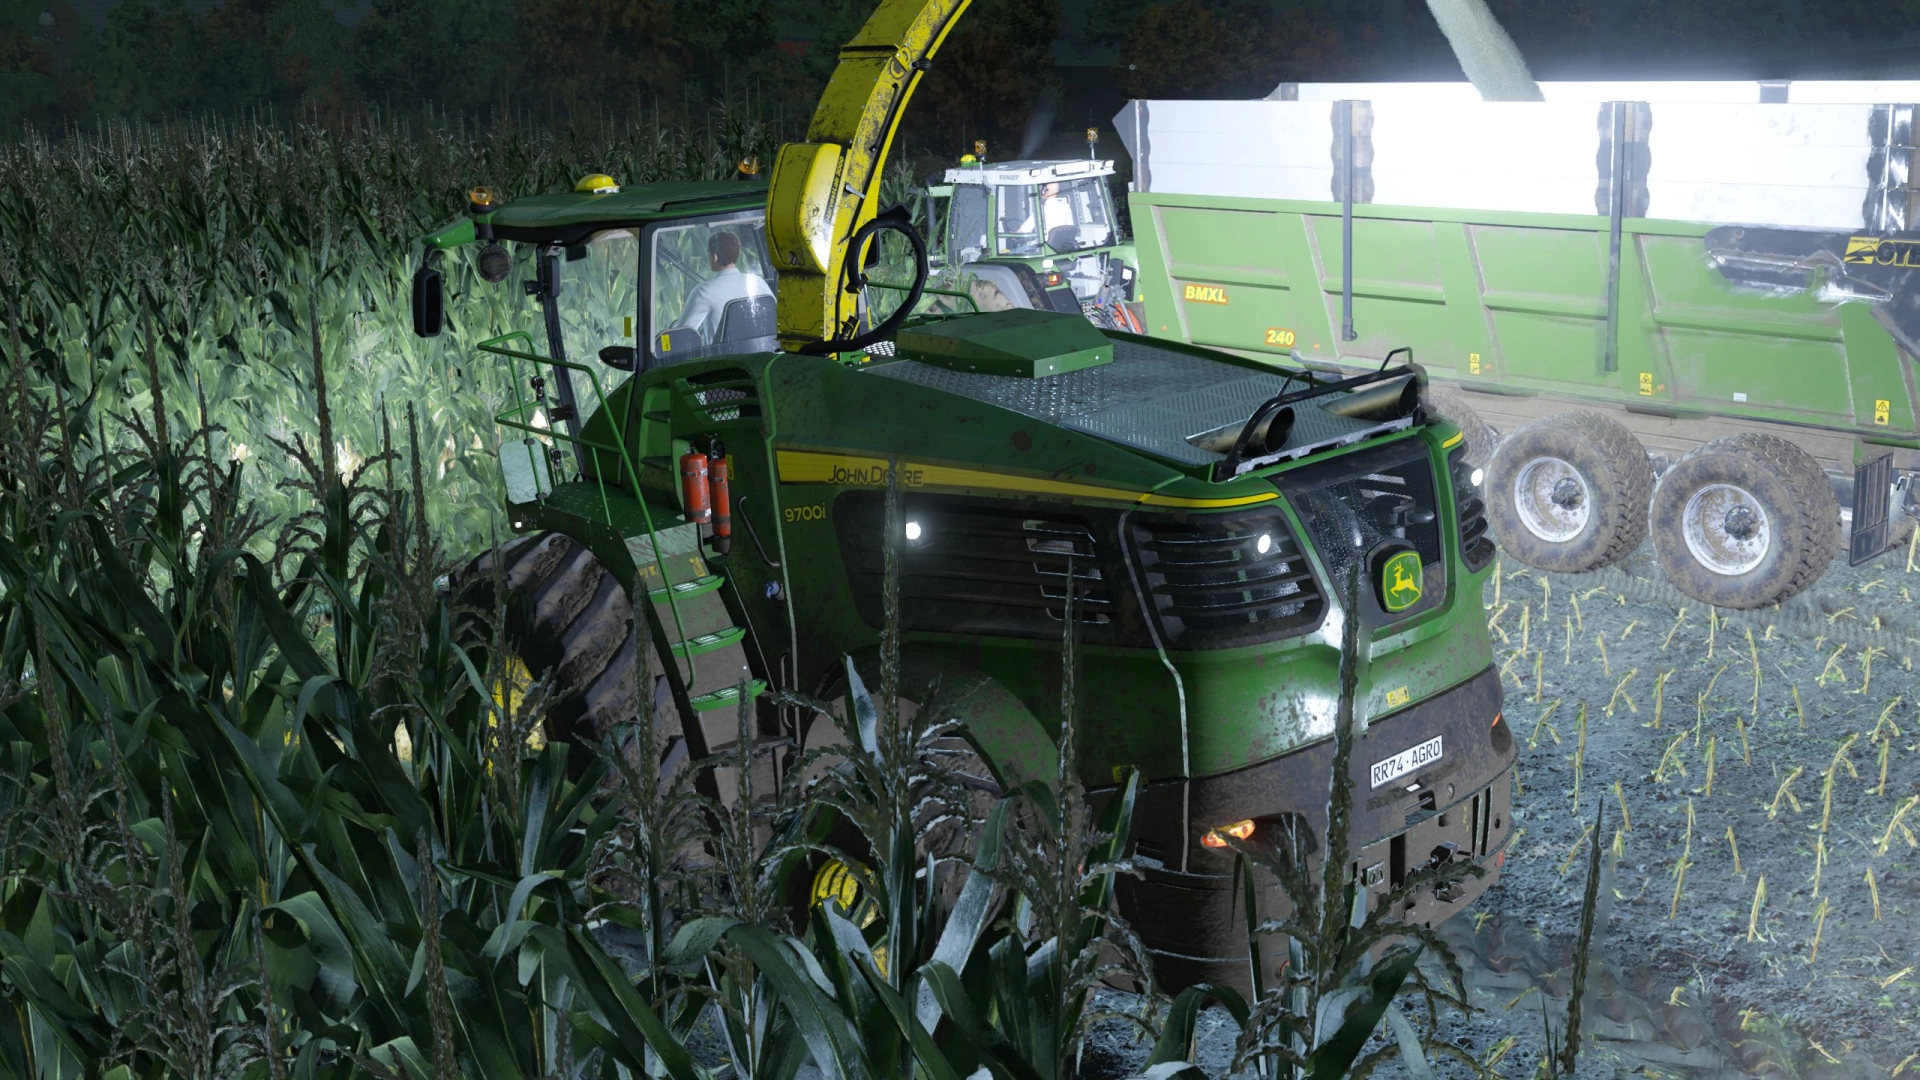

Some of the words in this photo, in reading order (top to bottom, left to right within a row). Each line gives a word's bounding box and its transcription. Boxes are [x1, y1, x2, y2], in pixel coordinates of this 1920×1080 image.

[1184, 285, 1228, 303] BMXL
[1266, 329, 1295, 346] 240
[827, 464, 868, 484] JOHN
[870, 465, 924, 486] DRE
[784, 502, 827, 523] 9700i
